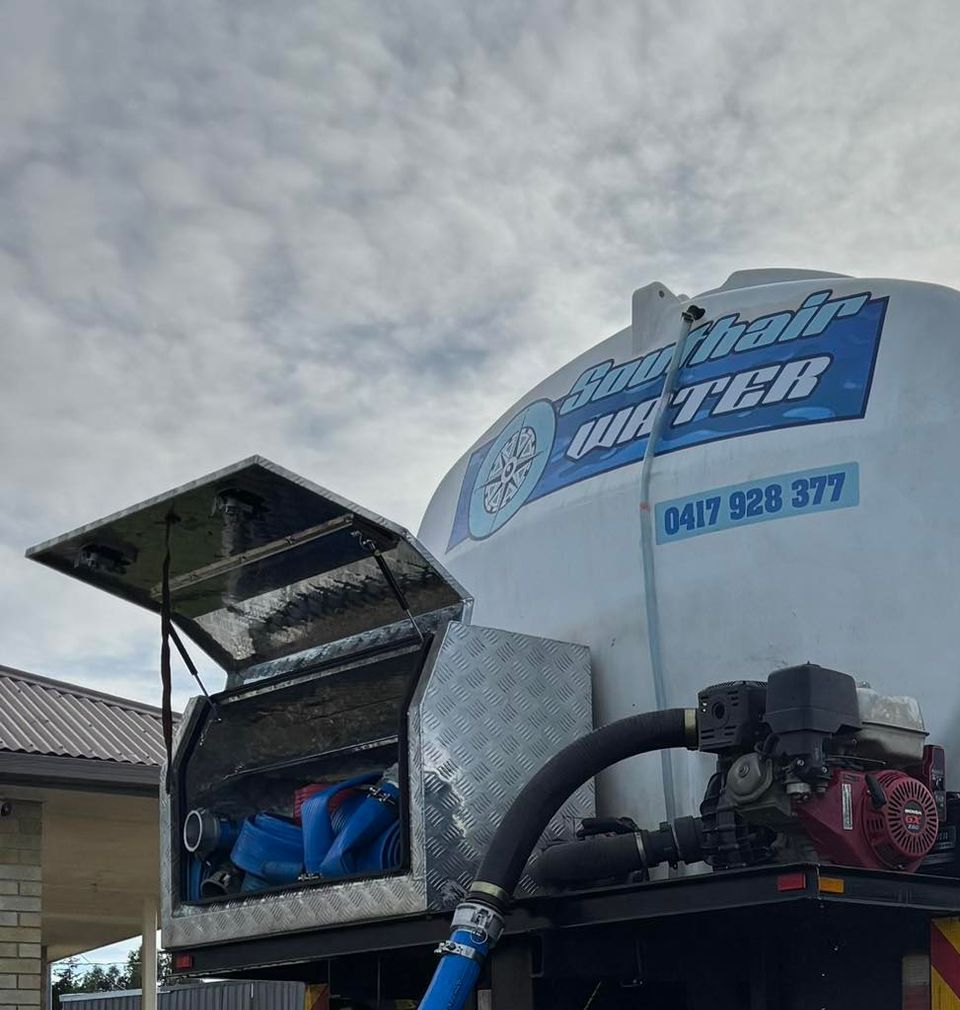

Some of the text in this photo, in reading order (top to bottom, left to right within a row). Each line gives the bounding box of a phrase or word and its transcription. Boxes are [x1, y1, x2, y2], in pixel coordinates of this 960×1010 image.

[559, 289, 871, 416] Southair
[565, 356, 832, 462] WATER
[664, 472, 846, 536] 0417 928 377
